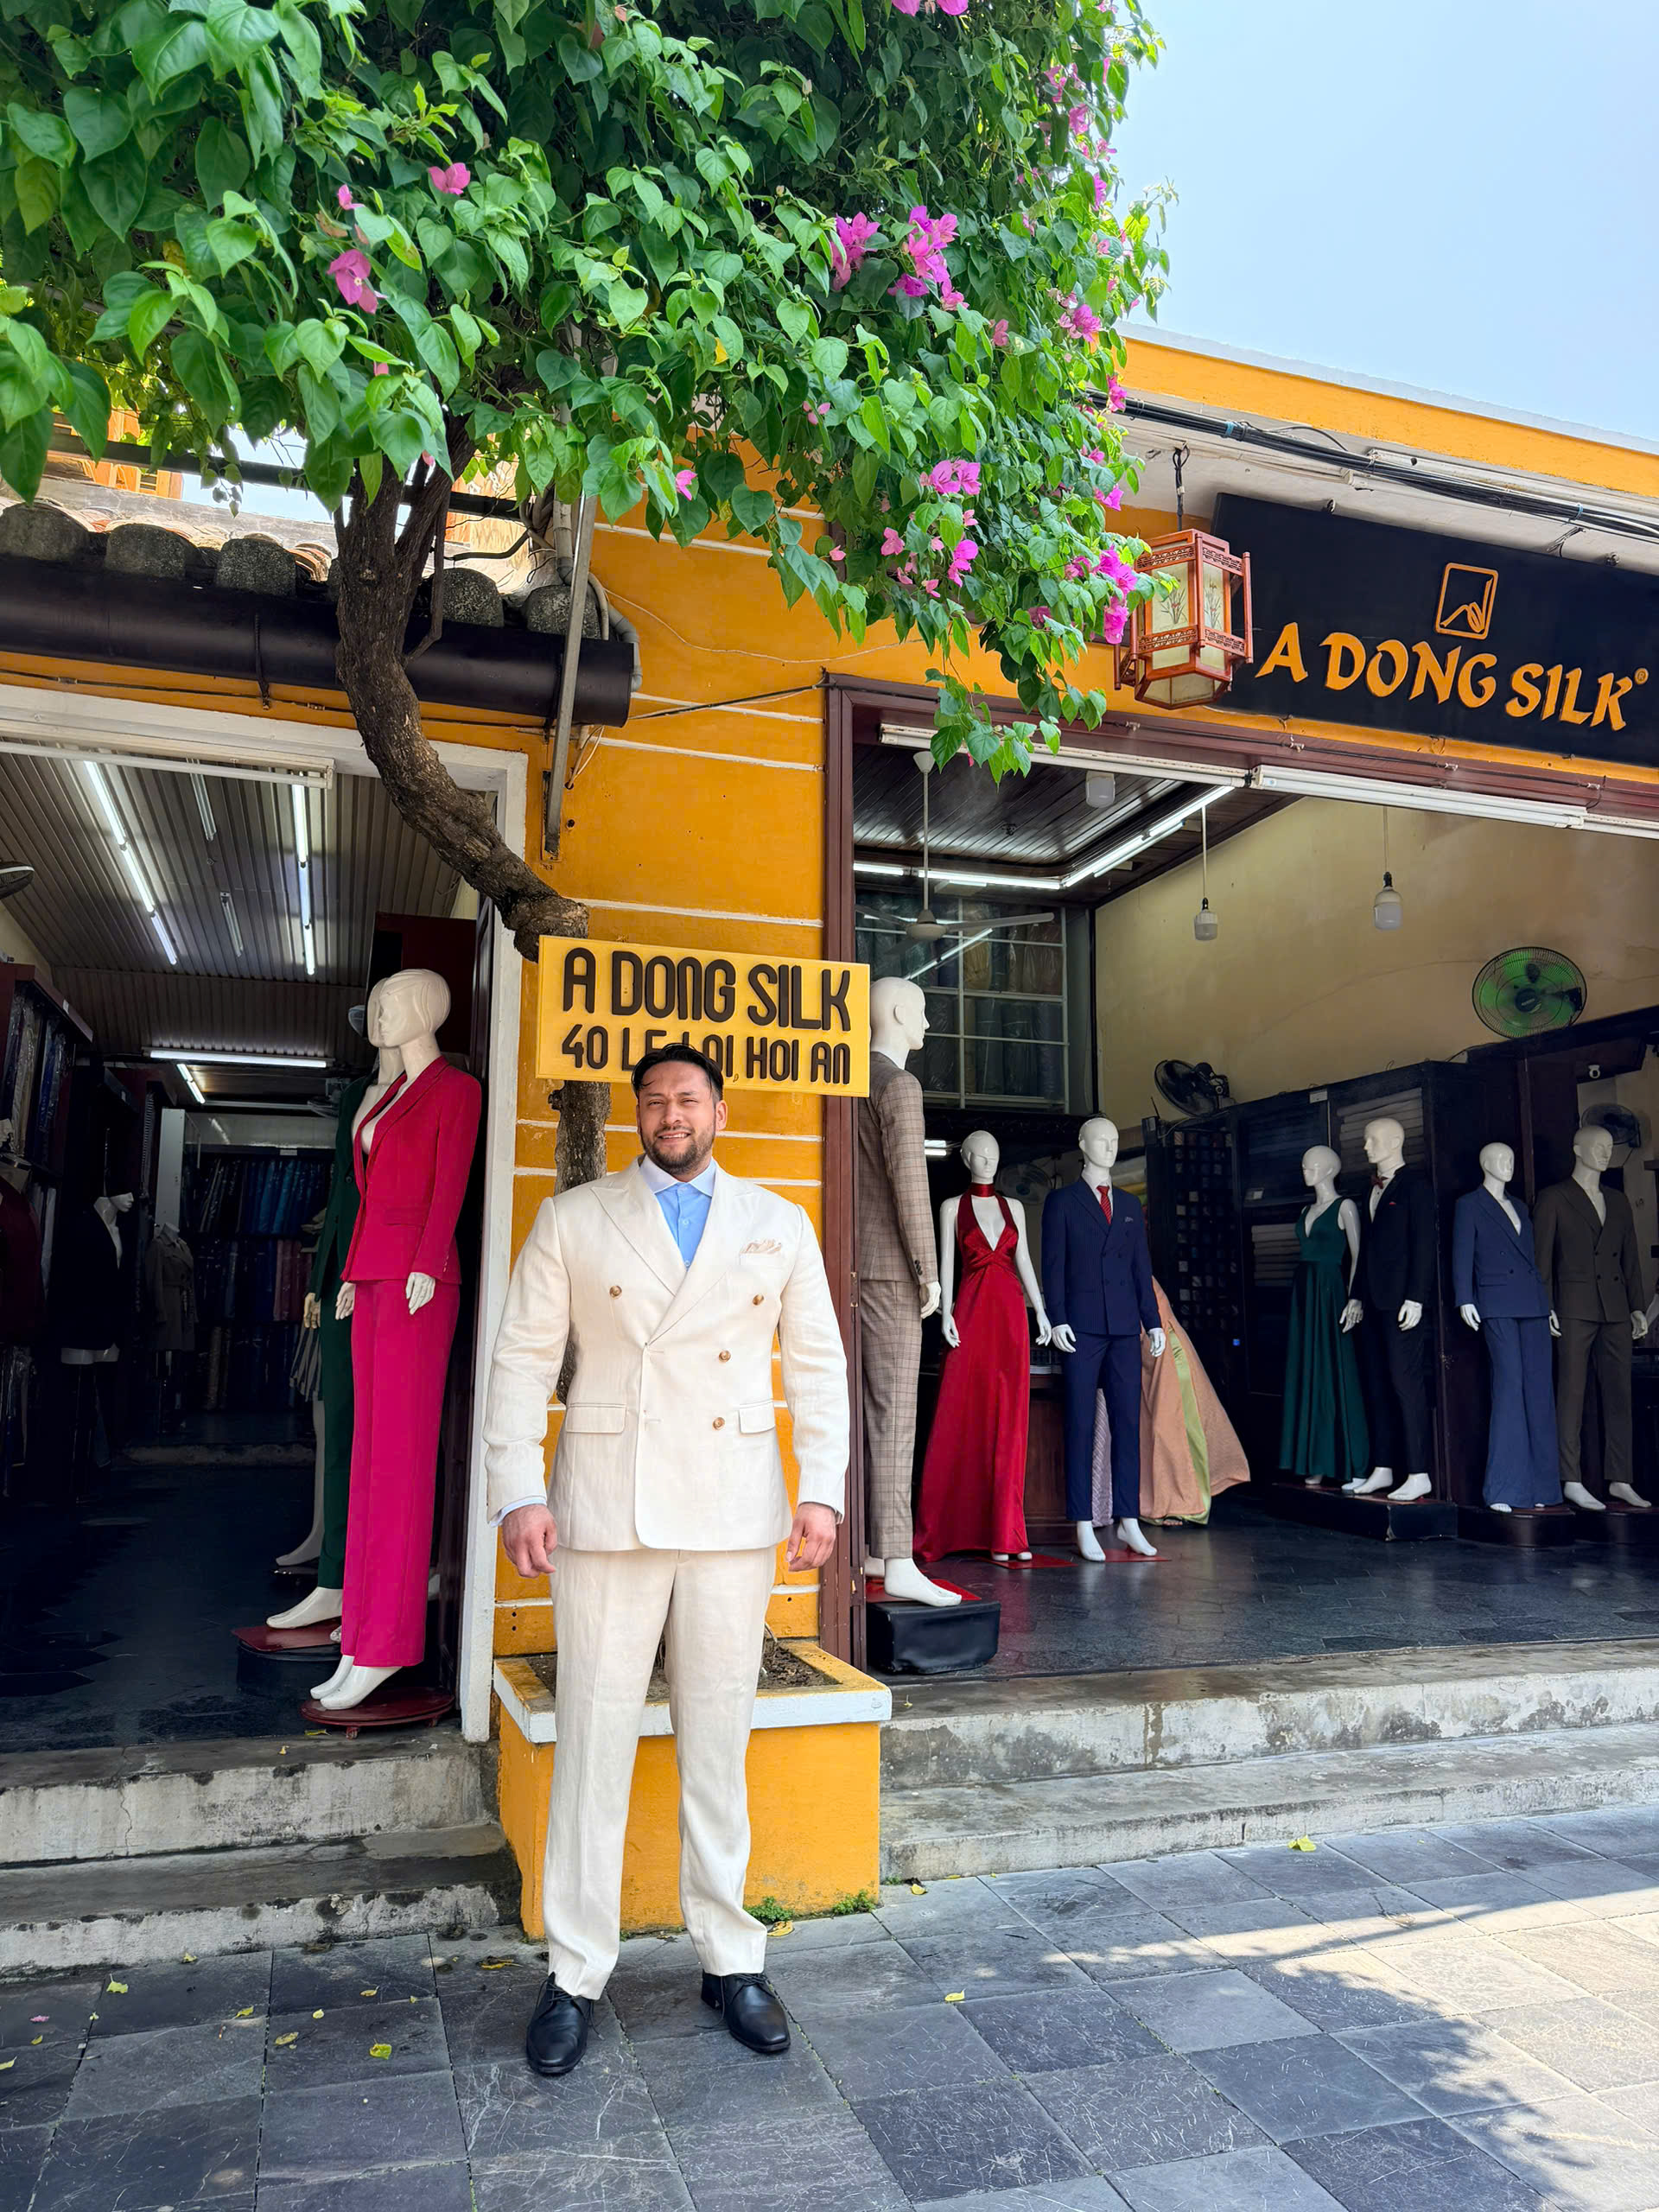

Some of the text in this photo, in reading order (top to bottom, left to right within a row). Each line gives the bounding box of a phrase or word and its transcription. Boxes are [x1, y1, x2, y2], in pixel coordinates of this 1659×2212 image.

[1255, 622, 1307, 683] A
[1320, 632, 1497, 709] DONG
[563, 947, 851, 1032] A DONG SILK
[562, 1024, 608, 1070] 40
[746, 1036, 799, 1082] HOI
[810, 1041, 851, 1085] AN
